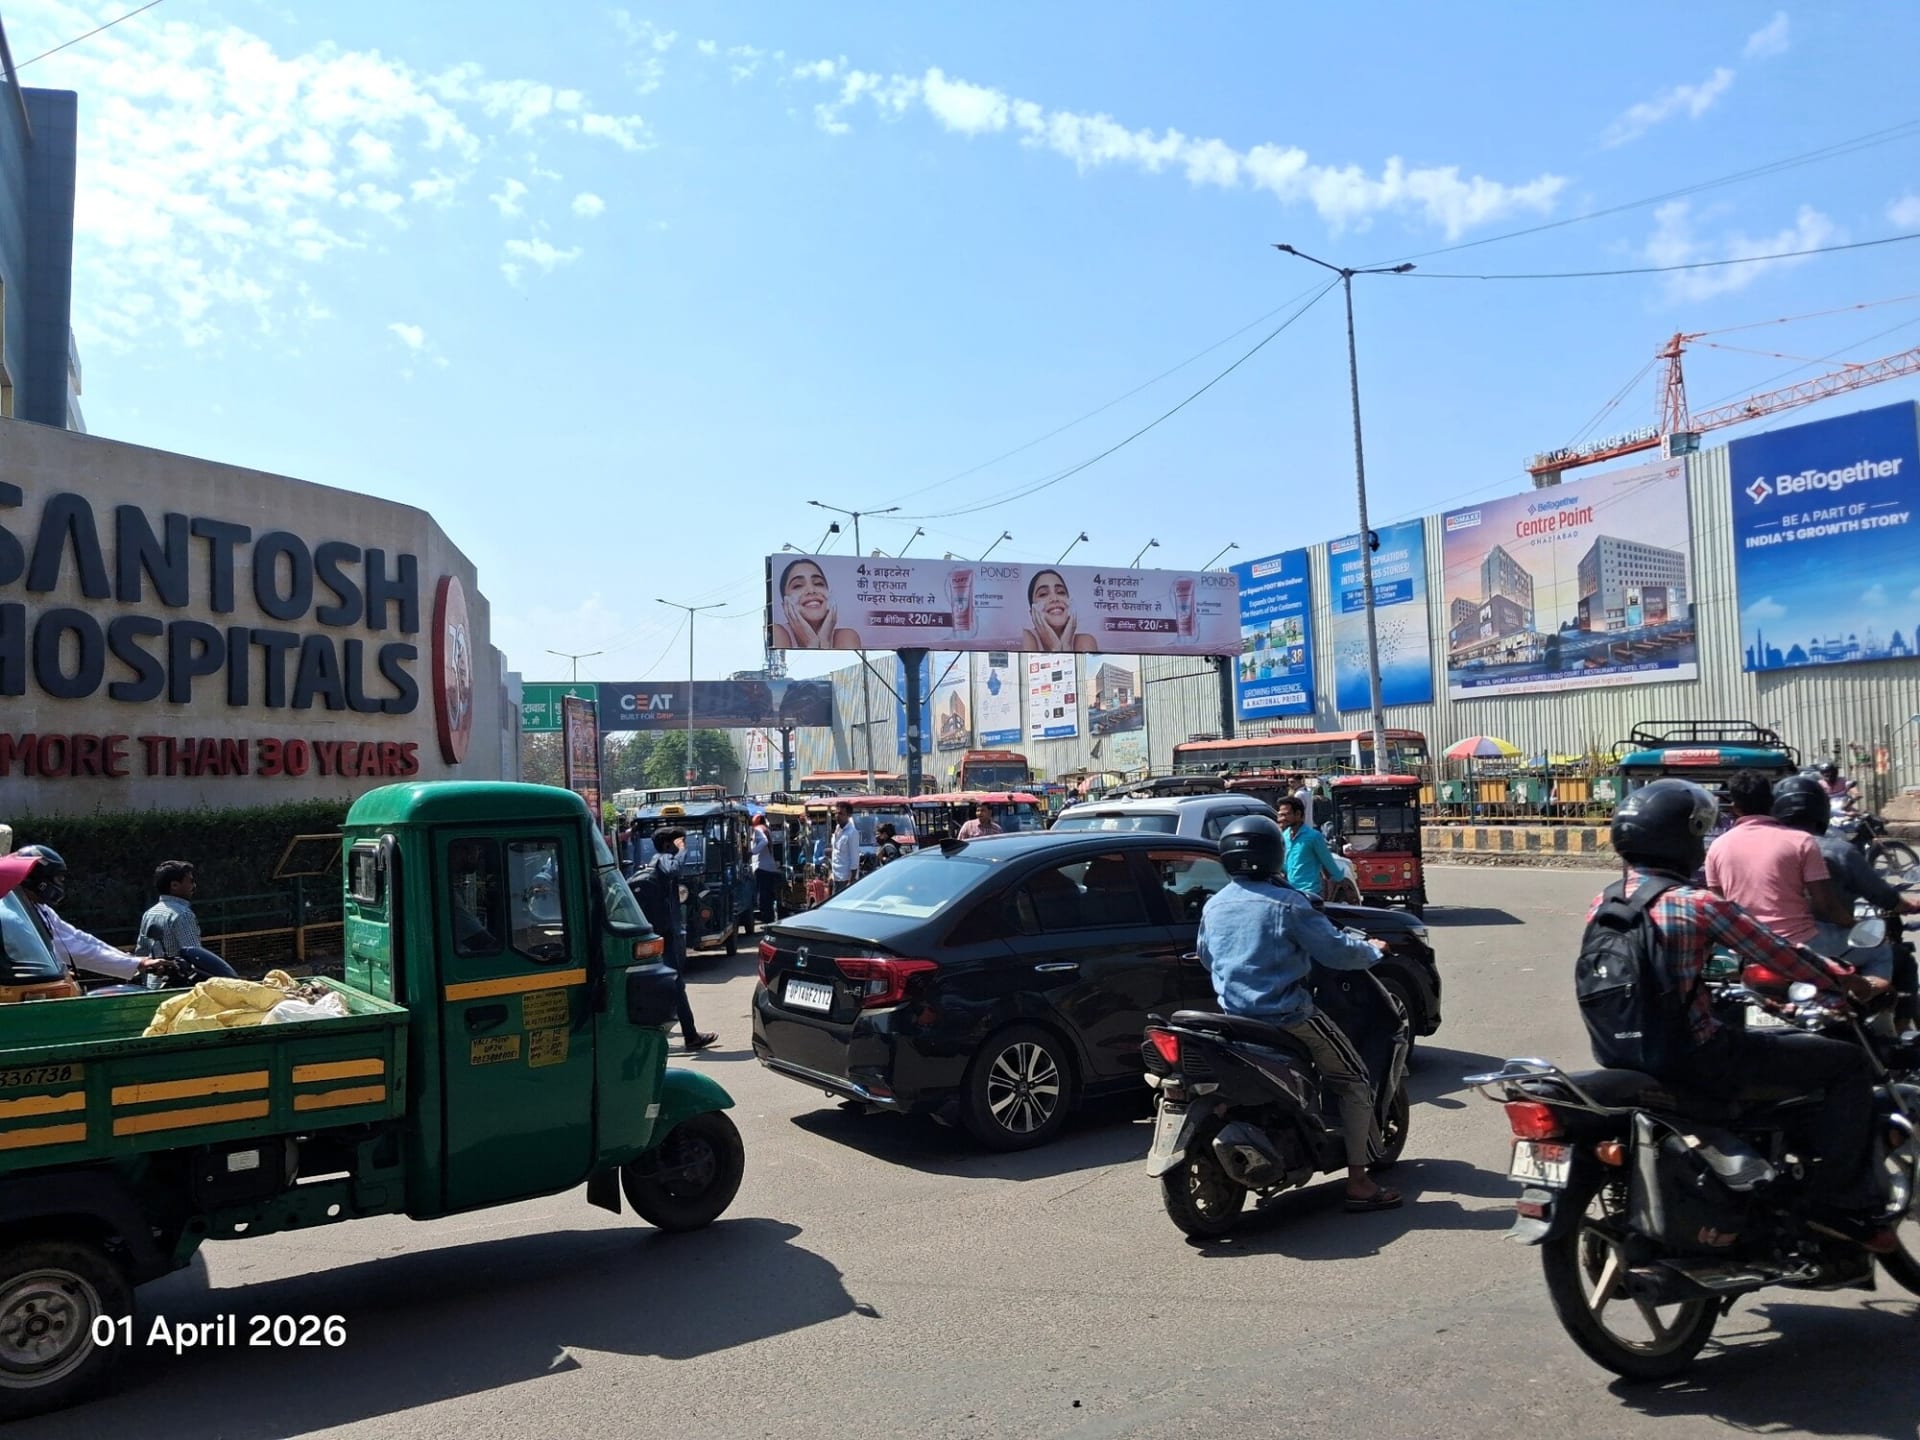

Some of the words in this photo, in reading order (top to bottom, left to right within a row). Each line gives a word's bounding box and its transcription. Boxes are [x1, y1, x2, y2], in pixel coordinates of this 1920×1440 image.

[1578, 425, 1655, 455] BETOGETHER
[1776, 458, 1903, 495] BeTogether
[1537, 496, 1579, 512] BeTogether
[1516, 518, 1556, 538] Centre
[1558, 505, 1593, 529] Point
[1782, 514, 1799, 527] BE
[1801, 512, 1810, 523] A
[1813, 506, 1846, 522] PART
[1848, 503, 1867, 515] OF
[1745, 530, 1795, 548] INDIA'S
[1796, 521, 1859, 539] GROWTH
[1861, 512, 1910, 530] STORY
[1530, 531, 1579, 546] GHAZIABAD
[1371, 549, 1408, 566] SPIRATIONS
[856, 564, 871, 577] 4x
[980, 566, 1020, 579] POND'S
[857, 577, 869, 589] की
[872, 580, 907, 592] शुरुआत
[1201, 576, 1236, 587] POND'S
[857, 592, 885, 604] पॉन्ड्स
[927, 592, 935, 604] से
[1094, 586, 1104, 597] की
[1107, 589, 1137, 600] शुरुआत
[1154, 601, 1162, 611] से
[908, 613, 936, 625] ₹20/-
[1290, 648, 1303, 664] 38
[1563, 670, 1580, 678] COURT
[1583, 666, 1617, 675] RESTAURANT
[1621, 664, 1638, 672] HOTEL
[1639, 662, 1659, 670] SUITES
[620, 694, 673, 710] CEAT
[1252, 696, 1281, 706] NATIONAL
[620, 713, 639, 721] BUILT
[656, 712, 674, 720] GRIP
[0, 733, 129, 777] MORE
[138, 736, 249, 776] THAN
[256, 738, 310, 777] 30
[312, 741, 420, 778] YEARS
